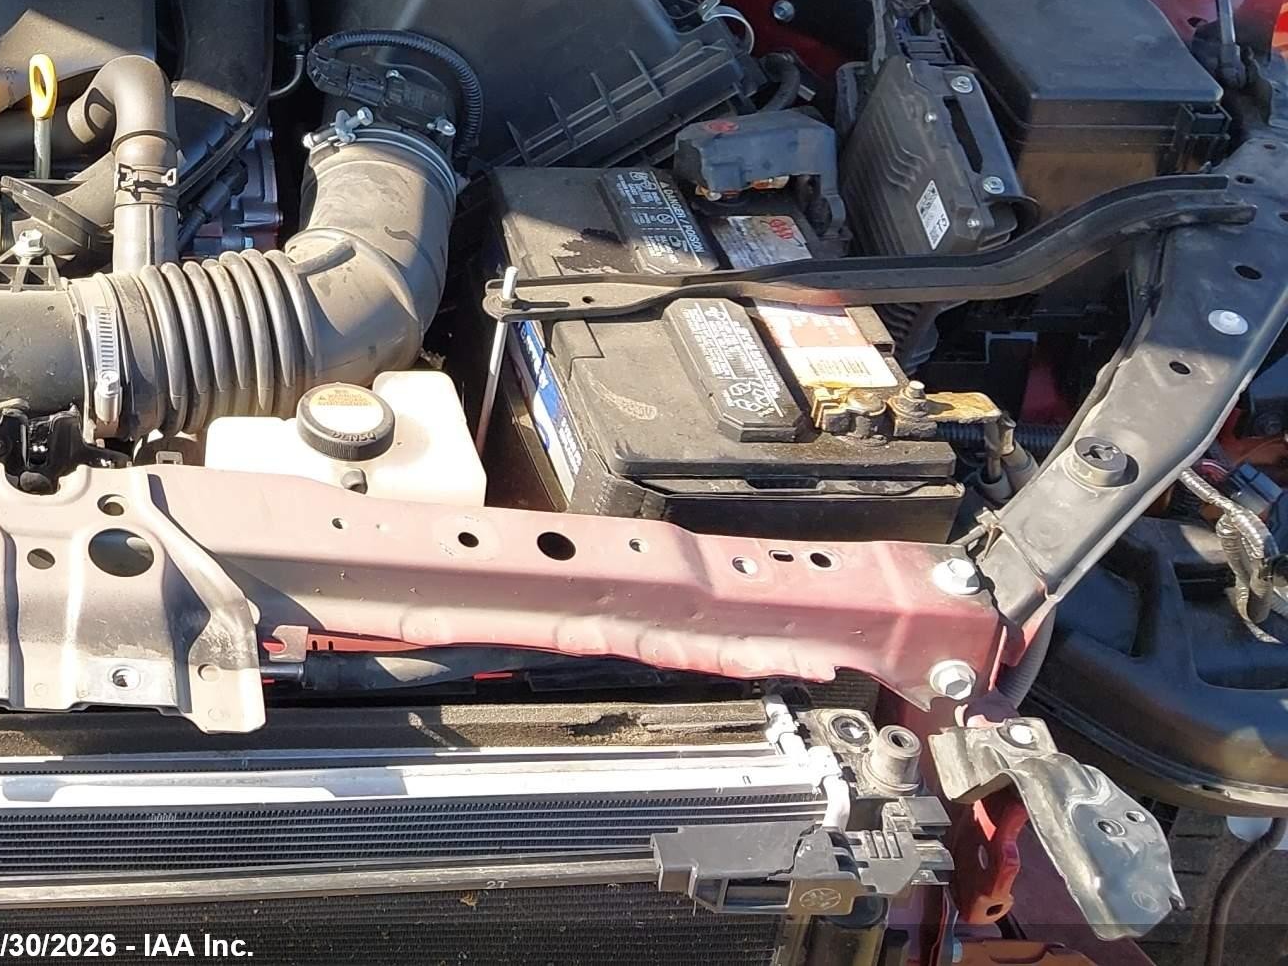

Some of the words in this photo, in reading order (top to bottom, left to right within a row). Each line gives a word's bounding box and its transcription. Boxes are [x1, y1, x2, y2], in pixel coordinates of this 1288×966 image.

[663, 189, 687, 218] DANGER
[682, 224, 705, 253] POISON
[332, 431, 377, 442] DENSO
[486, 880, 509, 890] 2T
